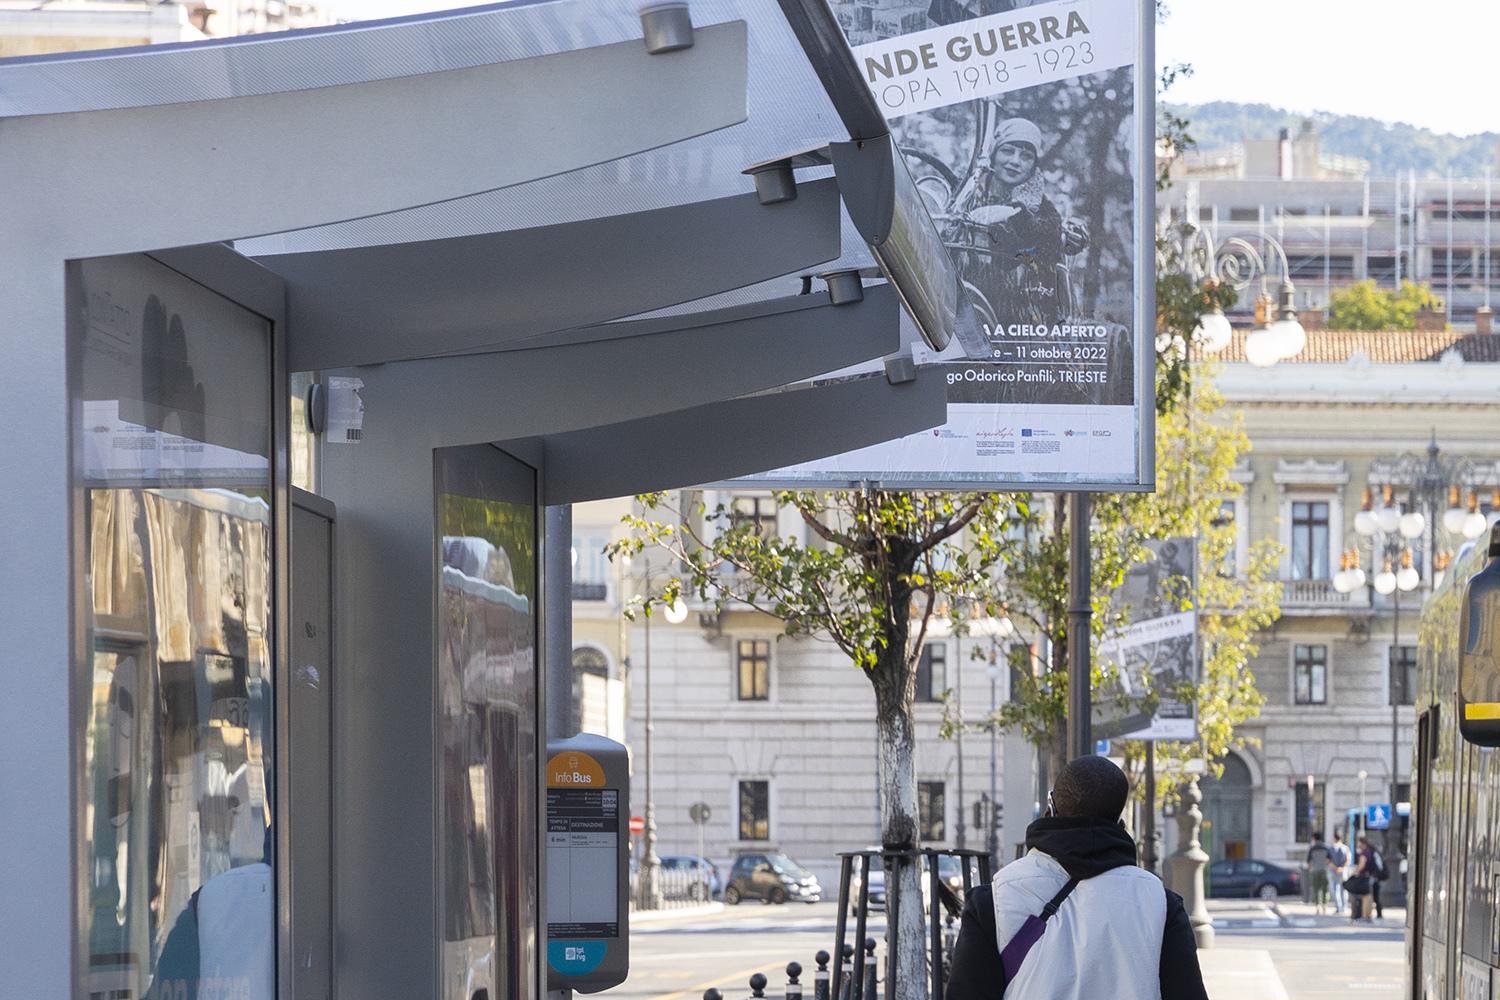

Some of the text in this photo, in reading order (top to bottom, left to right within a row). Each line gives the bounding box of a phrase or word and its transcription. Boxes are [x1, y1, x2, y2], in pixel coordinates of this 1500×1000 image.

[945, 10, 1091, 63] GUERRA
[994, 323, 1006, 337] A
[1008, 324, 1049, 338] CIELO
[1051, 324, 1108, 338] APERTO
[1016, 346, 1026, 359] 11
[1030, 346, 1072, 360] ottobre
[1074, 347, 1107, 360] 2022
[964, 369, 1016, 383] Odorico
[1017, 369, 1056, 385] Panfili,
[1058, 370, 1108, 384] TRIESTE
